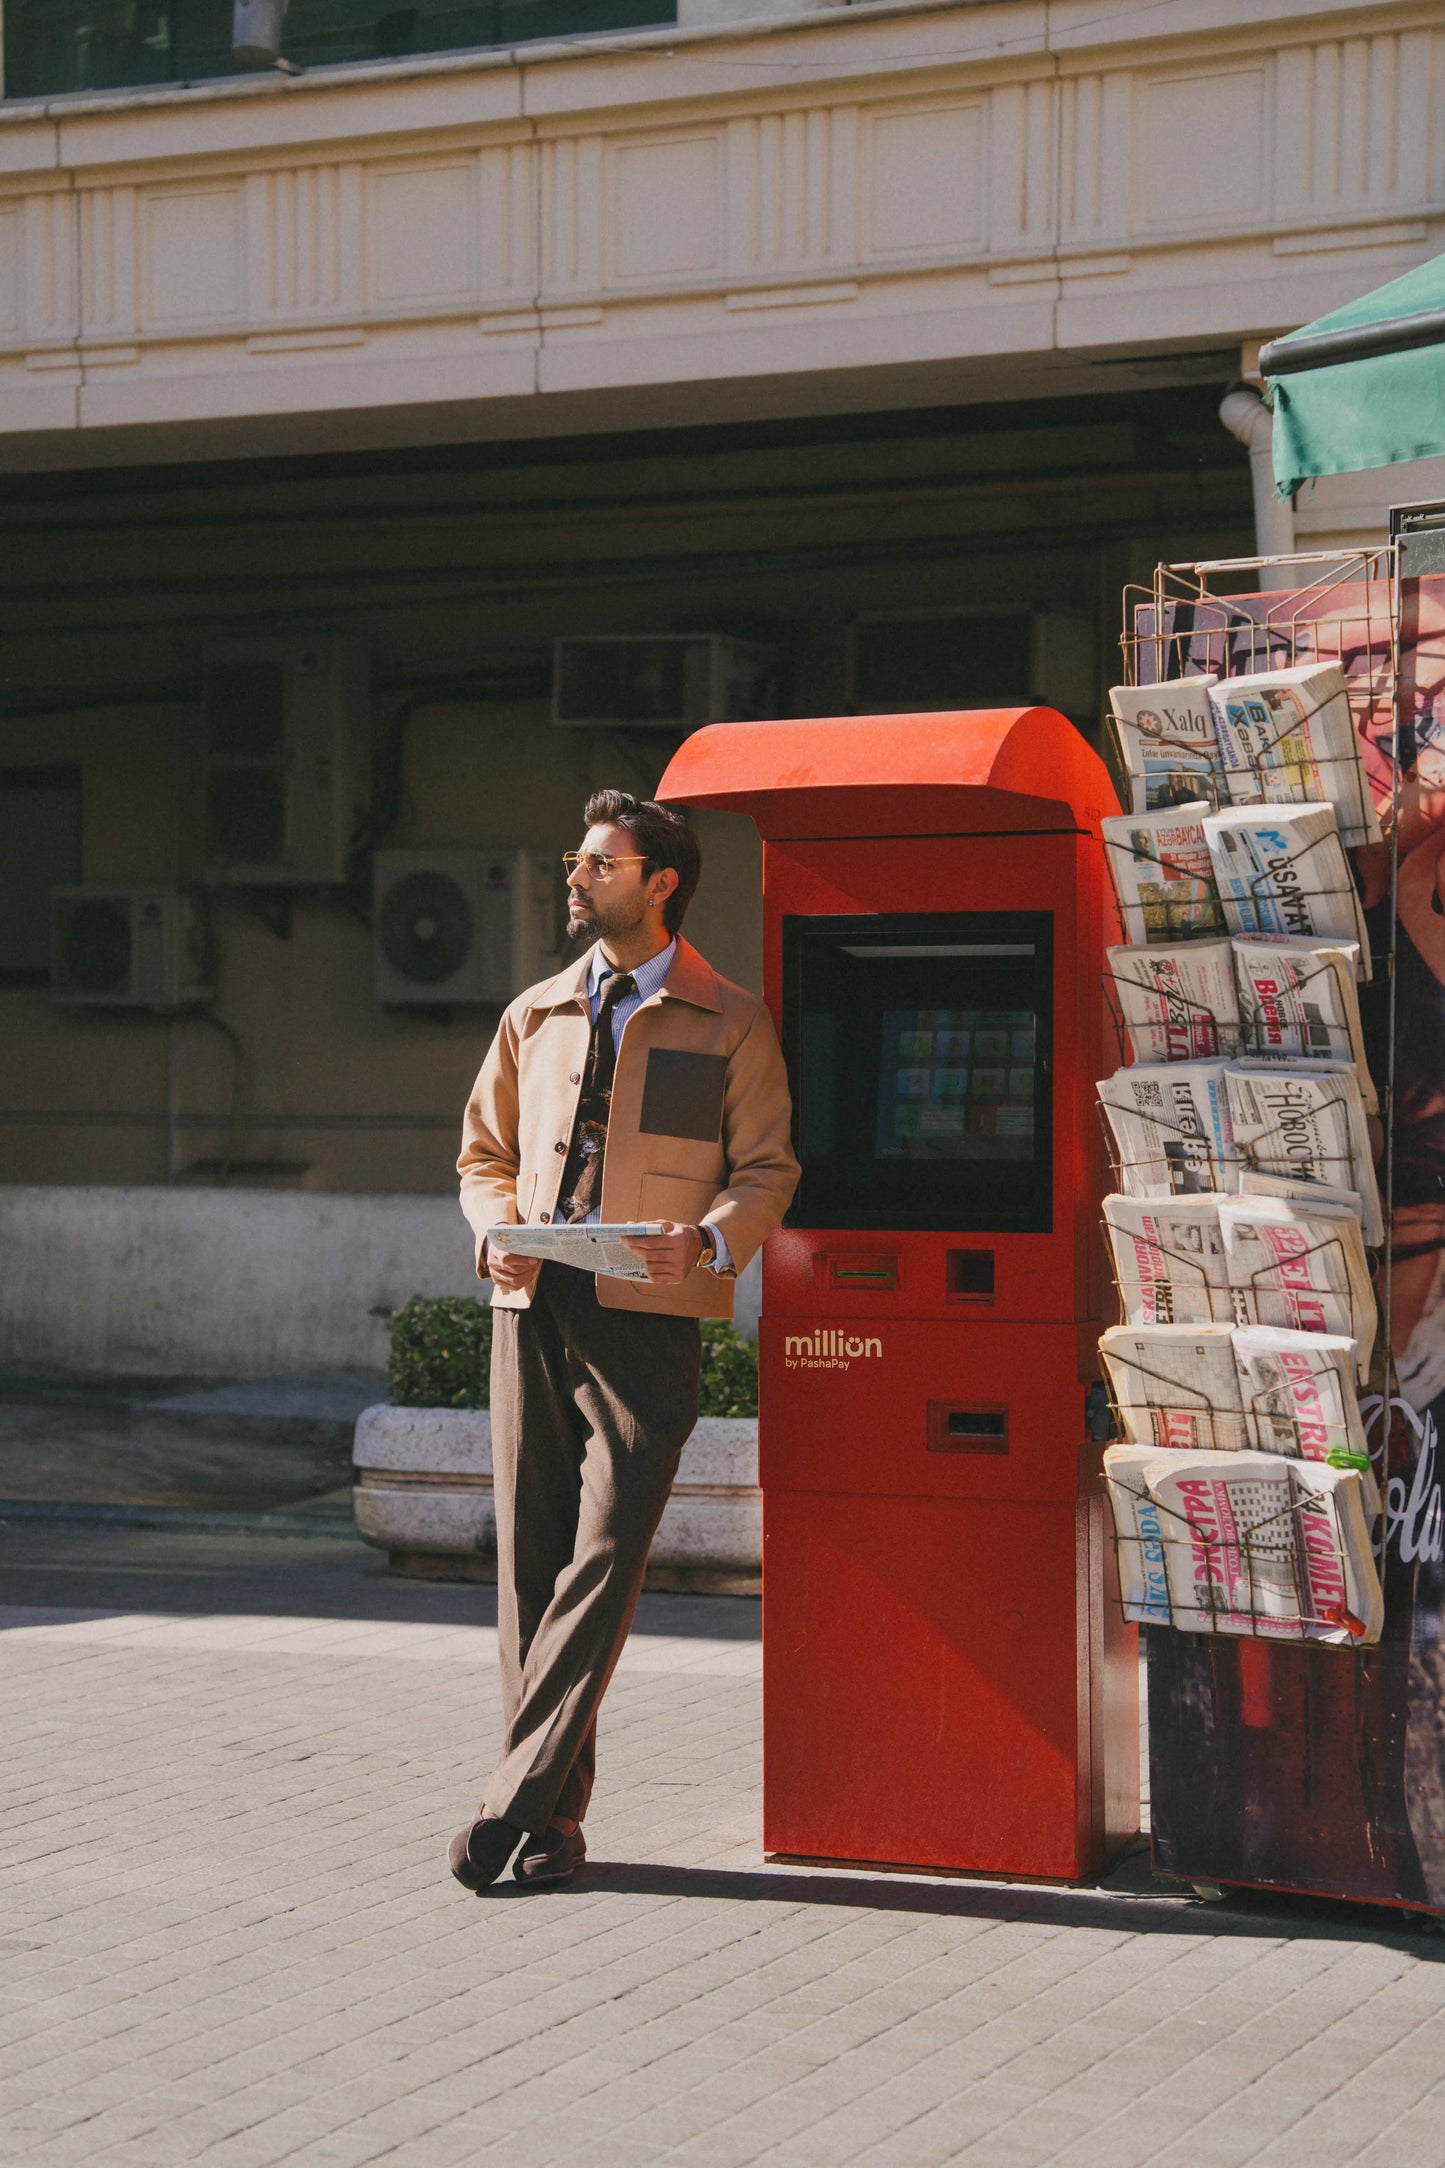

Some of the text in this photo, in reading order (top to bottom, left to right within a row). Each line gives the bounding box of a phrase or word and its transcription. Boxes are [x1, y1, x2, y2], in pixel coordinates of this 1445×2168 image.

[1162, 707, 1207, 738] Xalq
[1254, 979, 1282, 1044] Время
[785, 1329, 882, 1358] million
[785, 1358, 850, 1371] by PashaPay
[1176, 1480, 1224, 1584] ЭКСТРА
